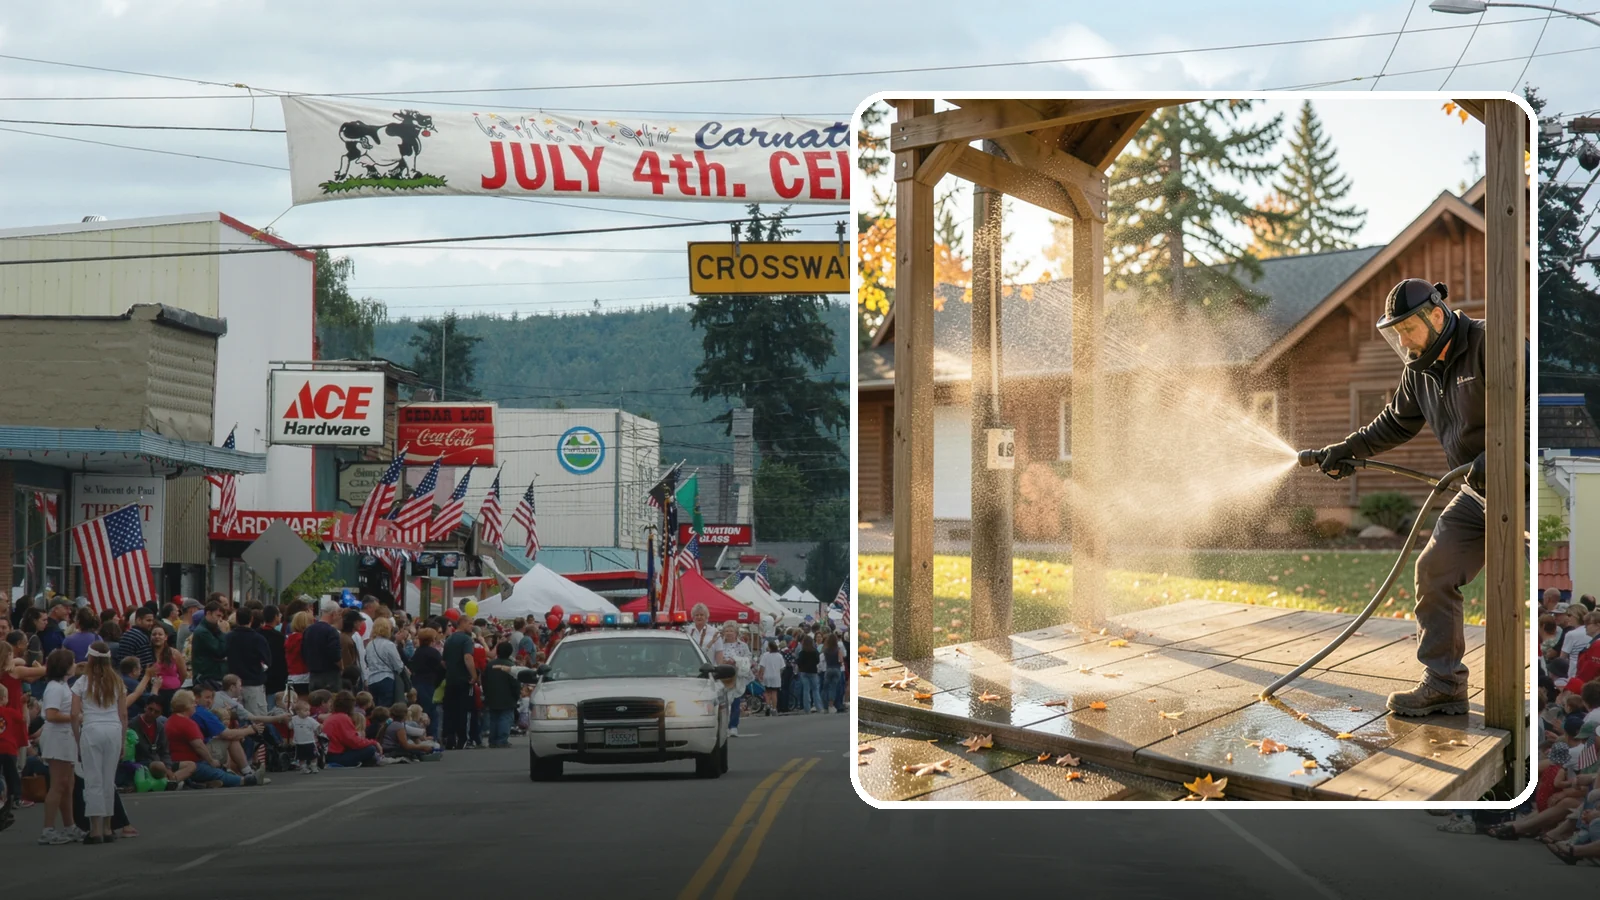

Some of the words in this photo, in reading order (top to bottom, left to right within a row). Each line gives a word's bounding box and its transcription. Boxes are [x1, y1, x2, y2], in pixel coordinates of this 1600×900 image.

[481, 141, 605, 193] JULY
[633, 150, 747, 198] 4th.
[696, 254, 850, 280] CROSSWA
[282, 380, 373, 420] ACE
[405, 409, 452, 421] CEDAR
[461, 409, 485, 421] LOG
[283, 421, 371, 437] Hardware
[416, 428, 477, 447] Coca-Cola
[353, 467, 384, 480] Simpl
[83, 485, 93, 494] St.
[95, 485, 124, 494] Vincent
[126, 486, 135, 494] de
[137, 486, 155, 495] Paul
[81, 503, 154, 522] THT
[212, 516, 330, 535] HARDARE
[688, 526, 741, 535] CRNATION
[699, 535, 730, 543] GLASS
